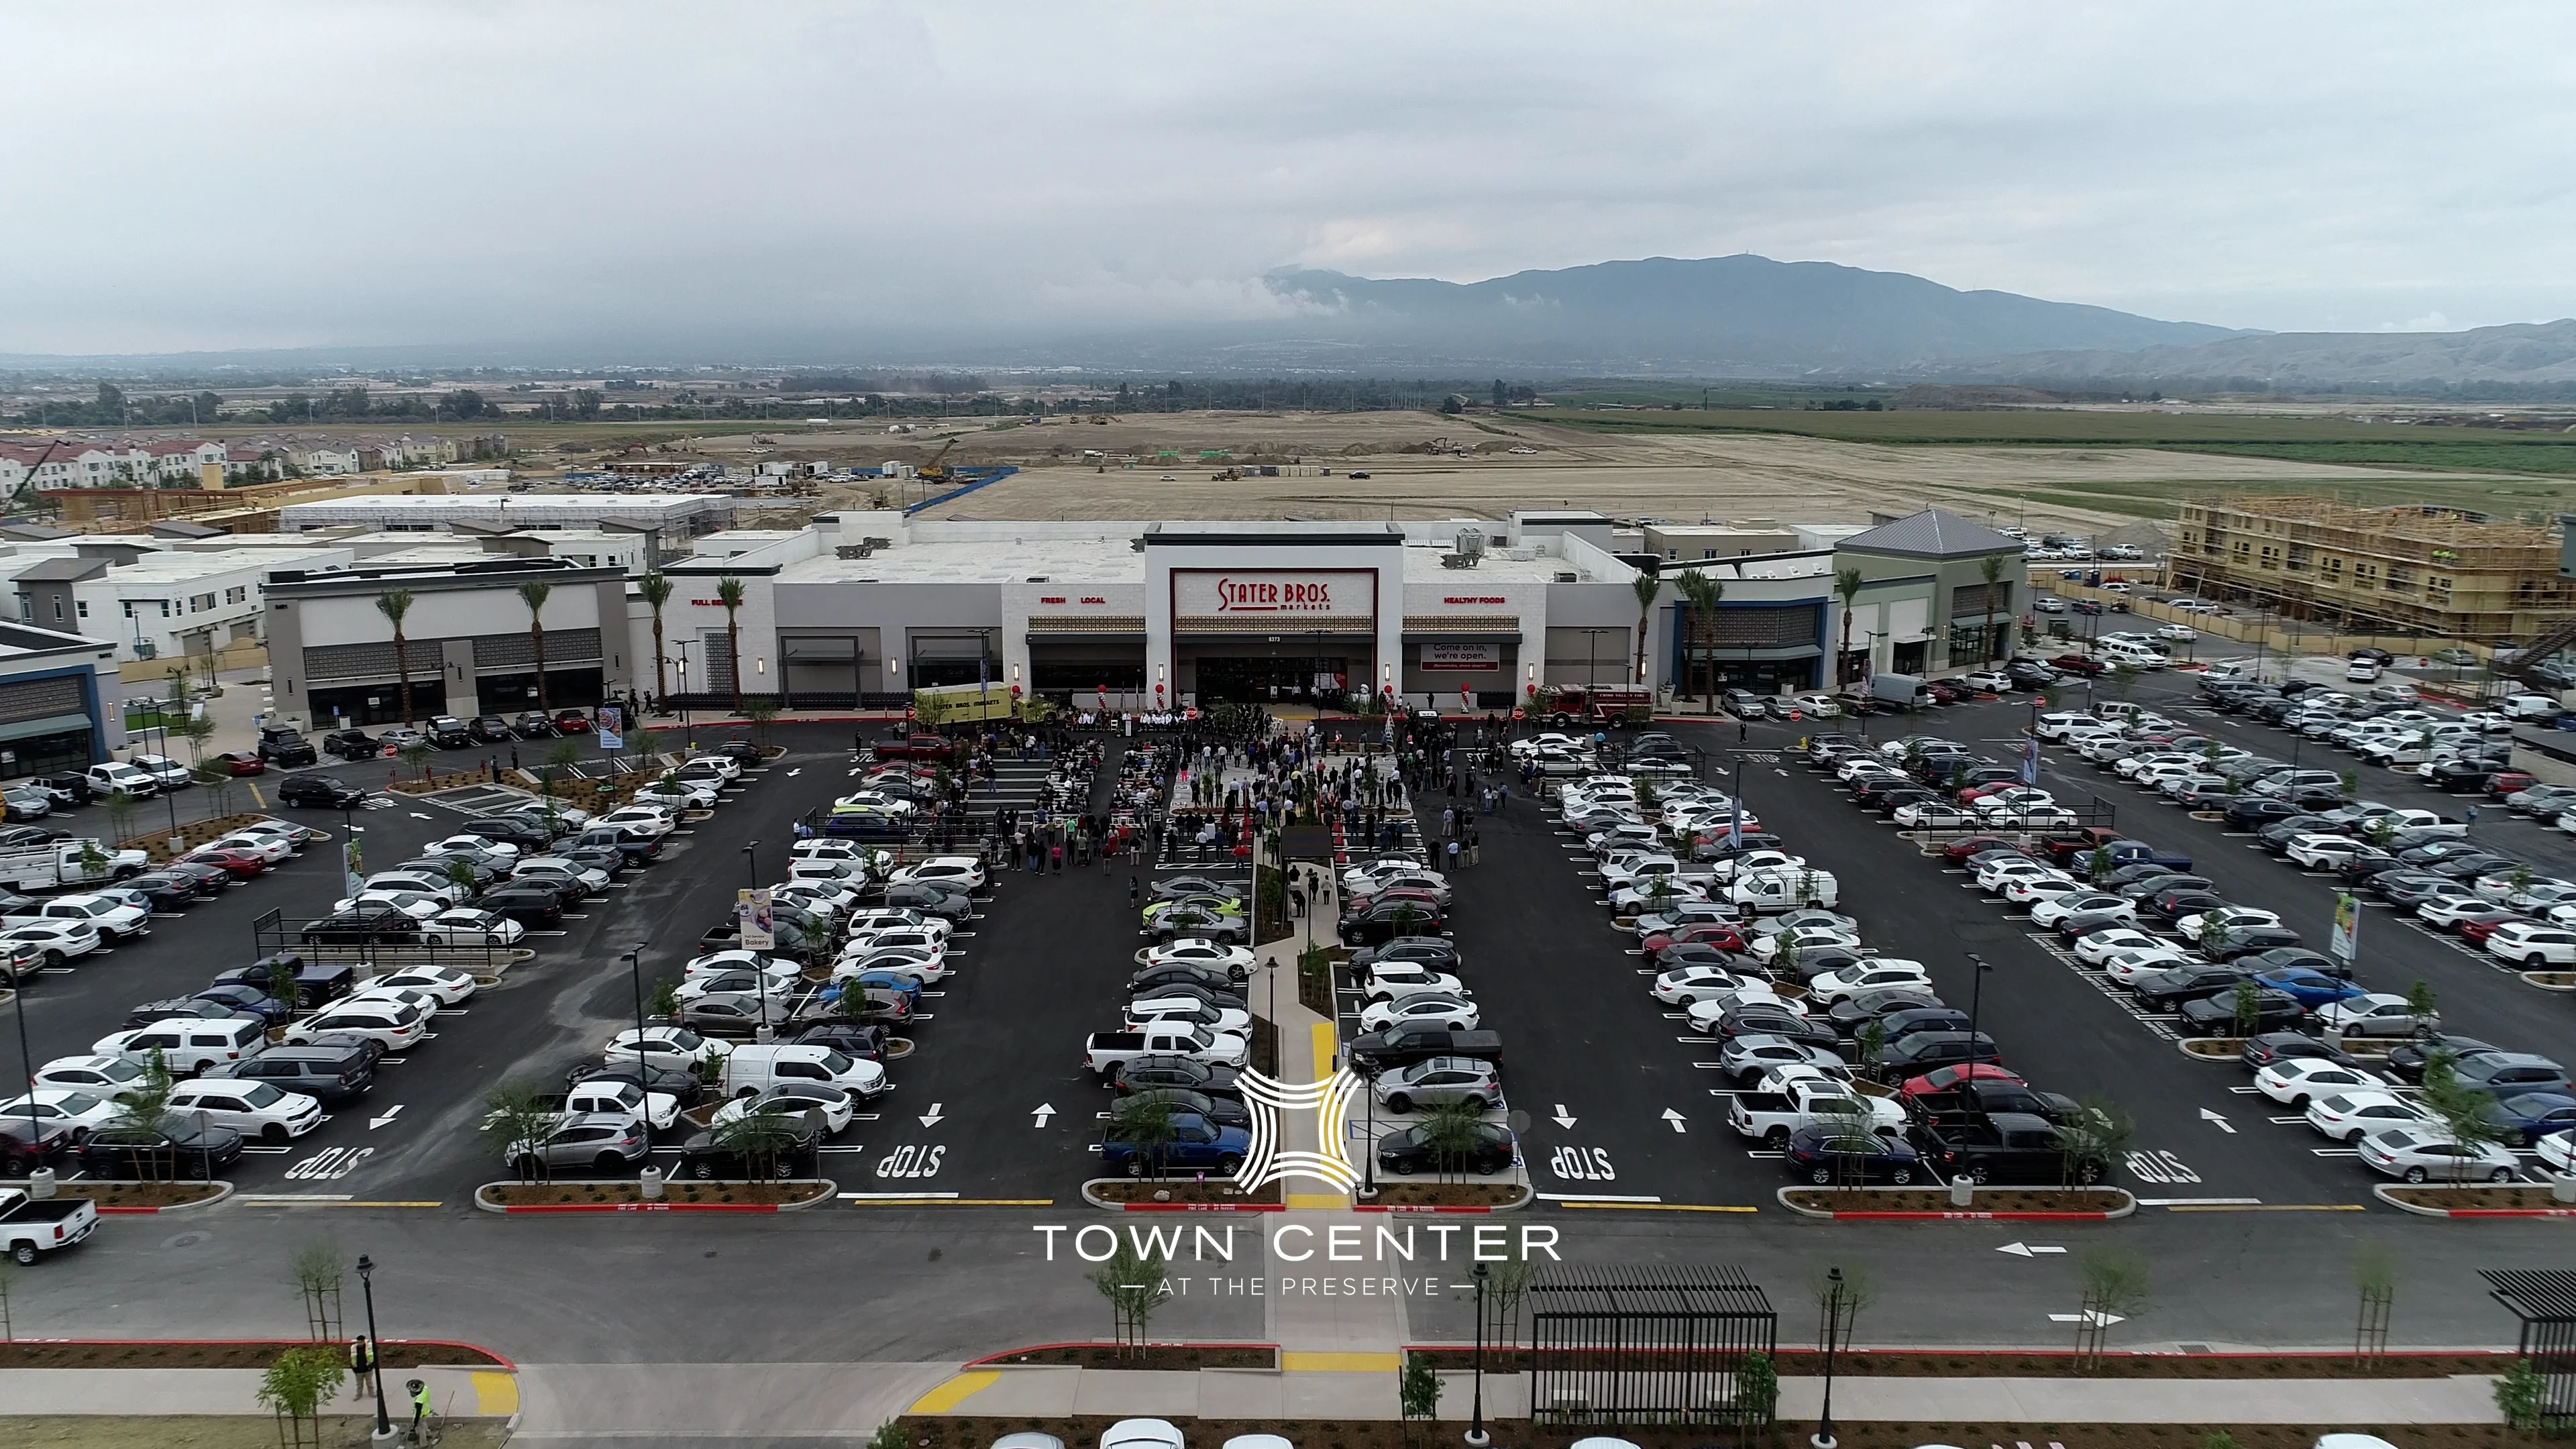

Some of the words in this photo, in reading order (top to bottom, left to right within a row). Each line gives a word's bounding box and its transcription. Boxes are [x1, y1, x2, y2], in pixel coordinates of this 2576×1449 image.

[1218, 578, 1277, 611] STATER
[1285, 584, 1330, 602] BROS.
[1746, 754, 1780, 763] STOP
[358, 797, 399, 810] STOP
[284, 1146, 374, 1180] STOP
[876, 1145, 947, 1178] STOP
[1550, 1146, 1615, 1181] STOP
[2121, 1150, 2202, 1183] STOP
